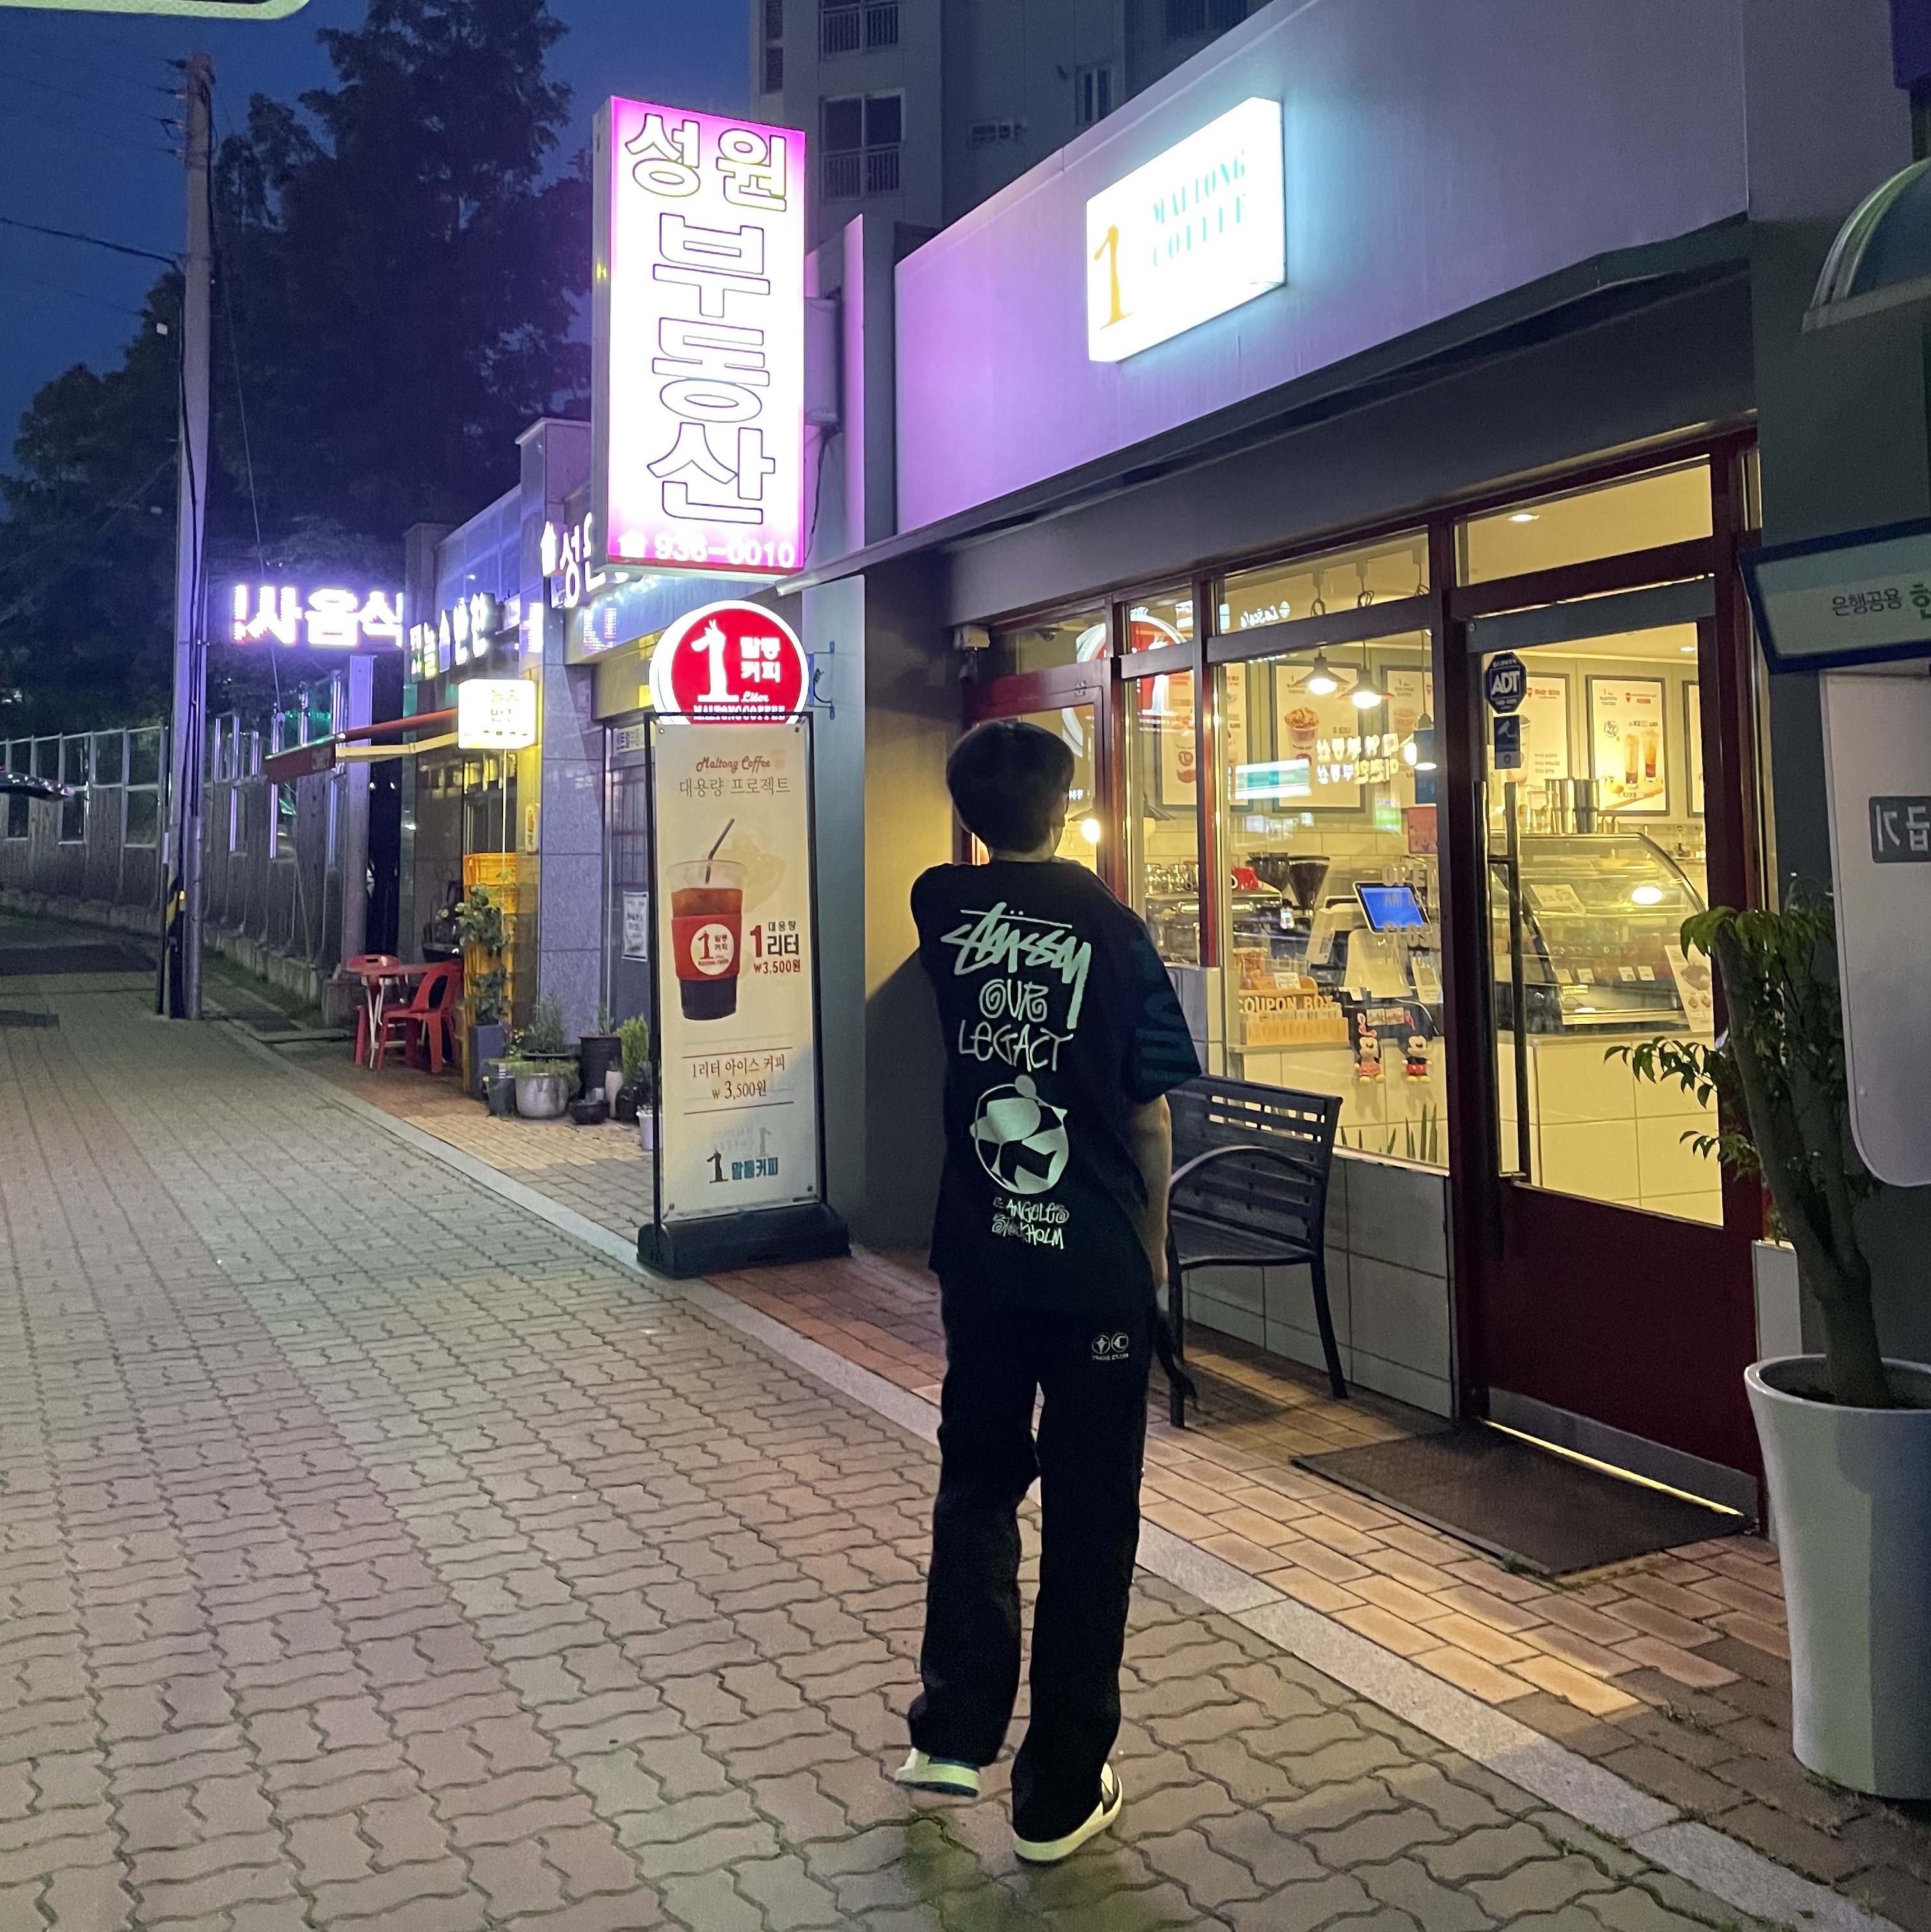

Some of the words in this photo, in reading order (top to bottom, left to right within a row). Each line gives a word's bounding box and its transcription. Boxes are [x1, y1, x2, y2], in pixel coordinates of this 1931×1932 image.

[625, 113, 787, 212] 성원
[1093, 224, 1133, 331] 1
[646, 213, 776, 525] 부동산
[1832, 588, 1902, 616] 은행공용
[741, 661, 780, 683] 커피
[1491, 671, 1520, 695] ADT
[696, 757, 738, 773] Maltong
[742, 756, 771, 773] Coffee
[679, 777, 725, 798] 대용량
[731, 776, 791, 795] 프로젝트
[979, 978, 1049, 1022] OUR
[1303, 994, 1334, 1010] BOX
[693, 1060, 720, 1079] 1리터
[725, 1058, 759, 1076] 아이스
[764, 1054, 785, 1073] 커피
